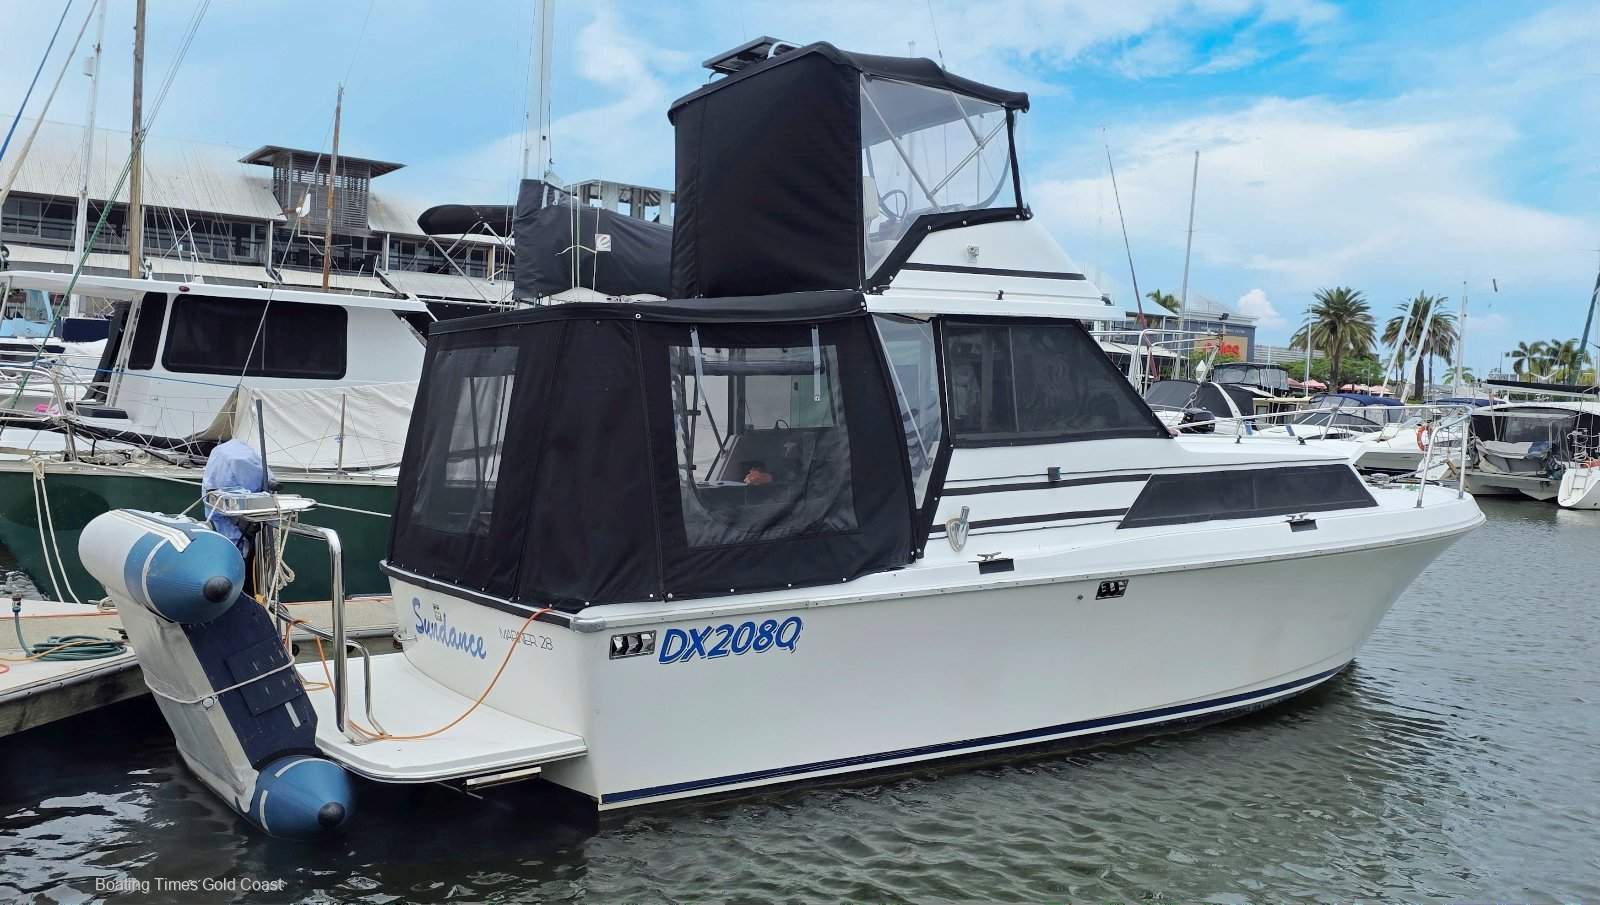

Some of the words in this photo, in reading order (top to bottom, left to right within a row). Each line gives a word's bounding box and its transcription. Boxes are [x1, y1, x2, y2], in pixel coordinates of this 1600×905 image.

[412, 597, 487, 660] Sundance
[499, 626, 538, 648] MARNER
[539, 635, 554, 651] 28
[658, 616, 804, 664] DX208Q
